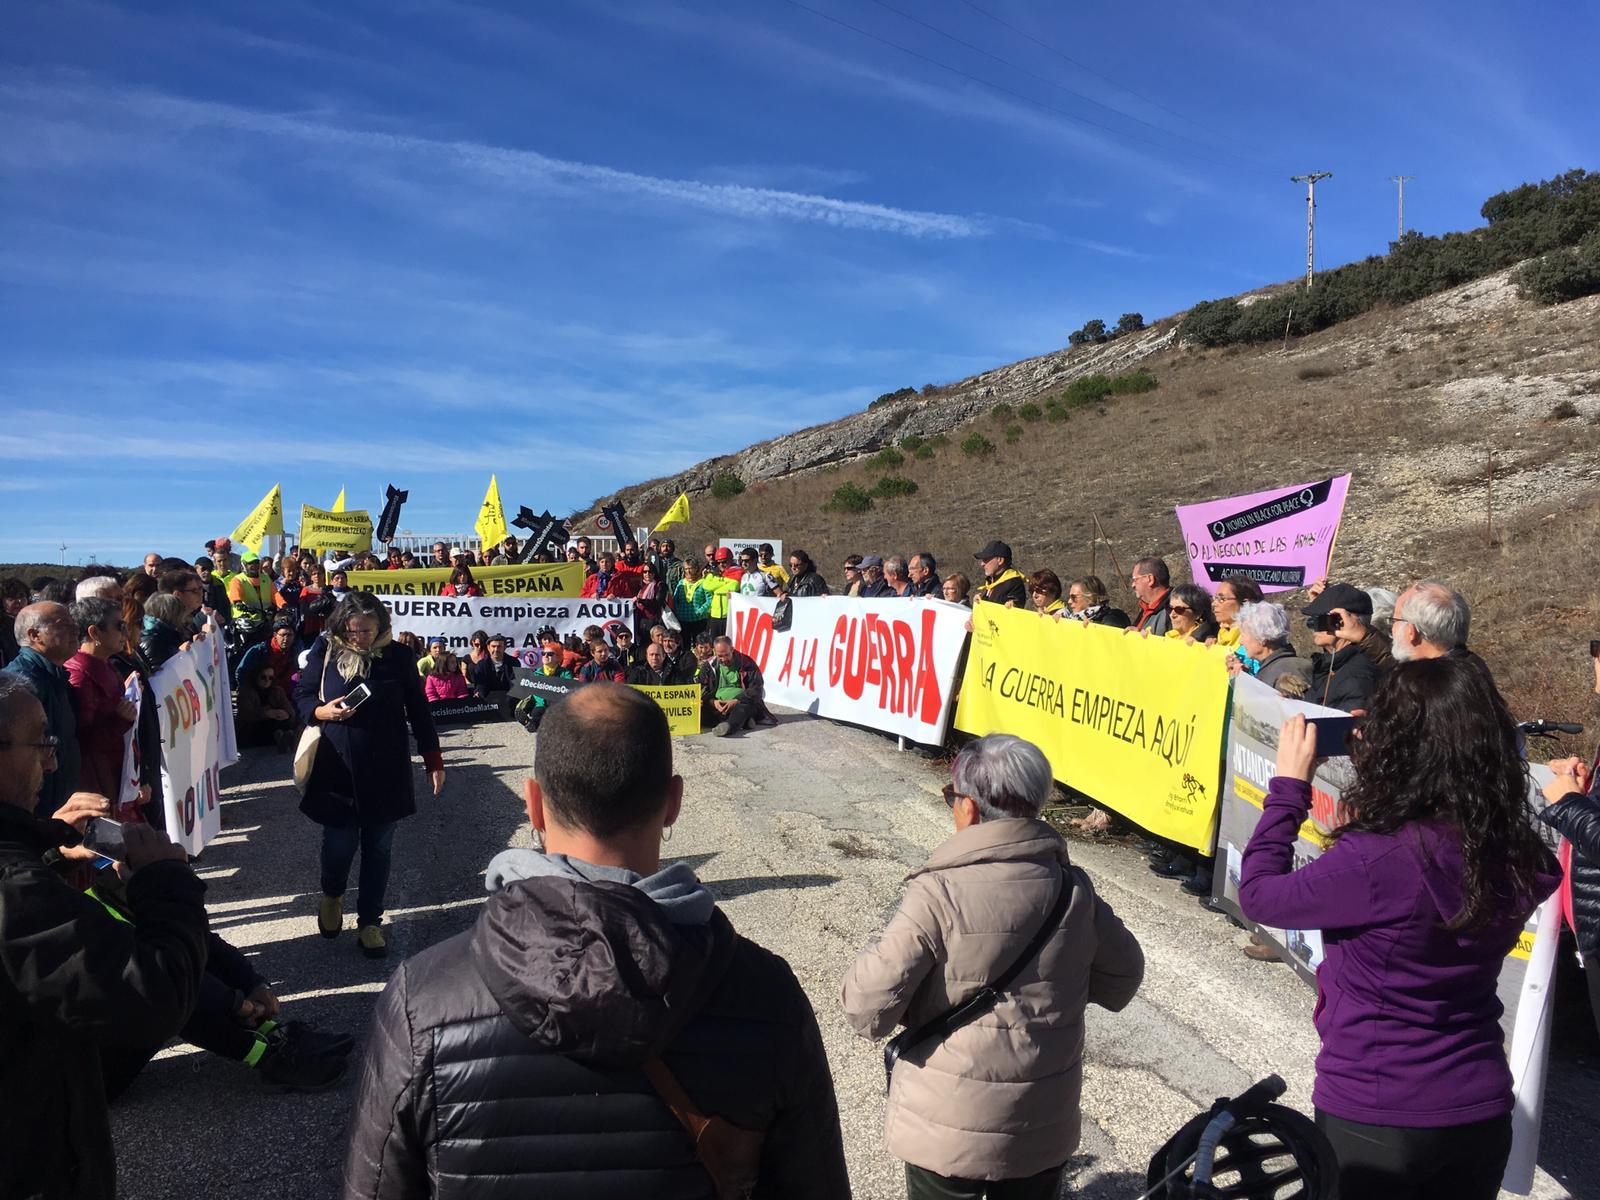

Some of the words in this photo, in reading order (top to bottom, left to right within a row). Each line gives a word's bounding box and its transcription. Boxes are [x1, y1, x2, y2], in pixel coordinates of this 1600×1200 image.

[1225, 515, 1249, 531] WOMEN
[1254, 506, 1271, 522] BLACK
[1270, 502, 1283, 517] FOR
[1284, 496, 1301, 513] PEACE
[1212, 542, 1251, 561] NEGOCIO
[1254, 540, 1265, 555] DE
[494, 574, 564, 594] ESPAÑA
[576, 600, 630, 619] AQUÍ
[778, 636, 794, 688] A
[798, 638, 818, 692] LA
[828, 608, 942, 726] GUERRA
[664, 688, 696, 700] ESPAÑA
[432, 702, 499, 718] ecisionesQueMatan
[980, 656, 997, 692] LA
[1000, 667, 1065, 718] GUERRA
[1071, 688, 1146, 749] EMPIEZA
[1150, 714, 1196, 768] AQUÍ
